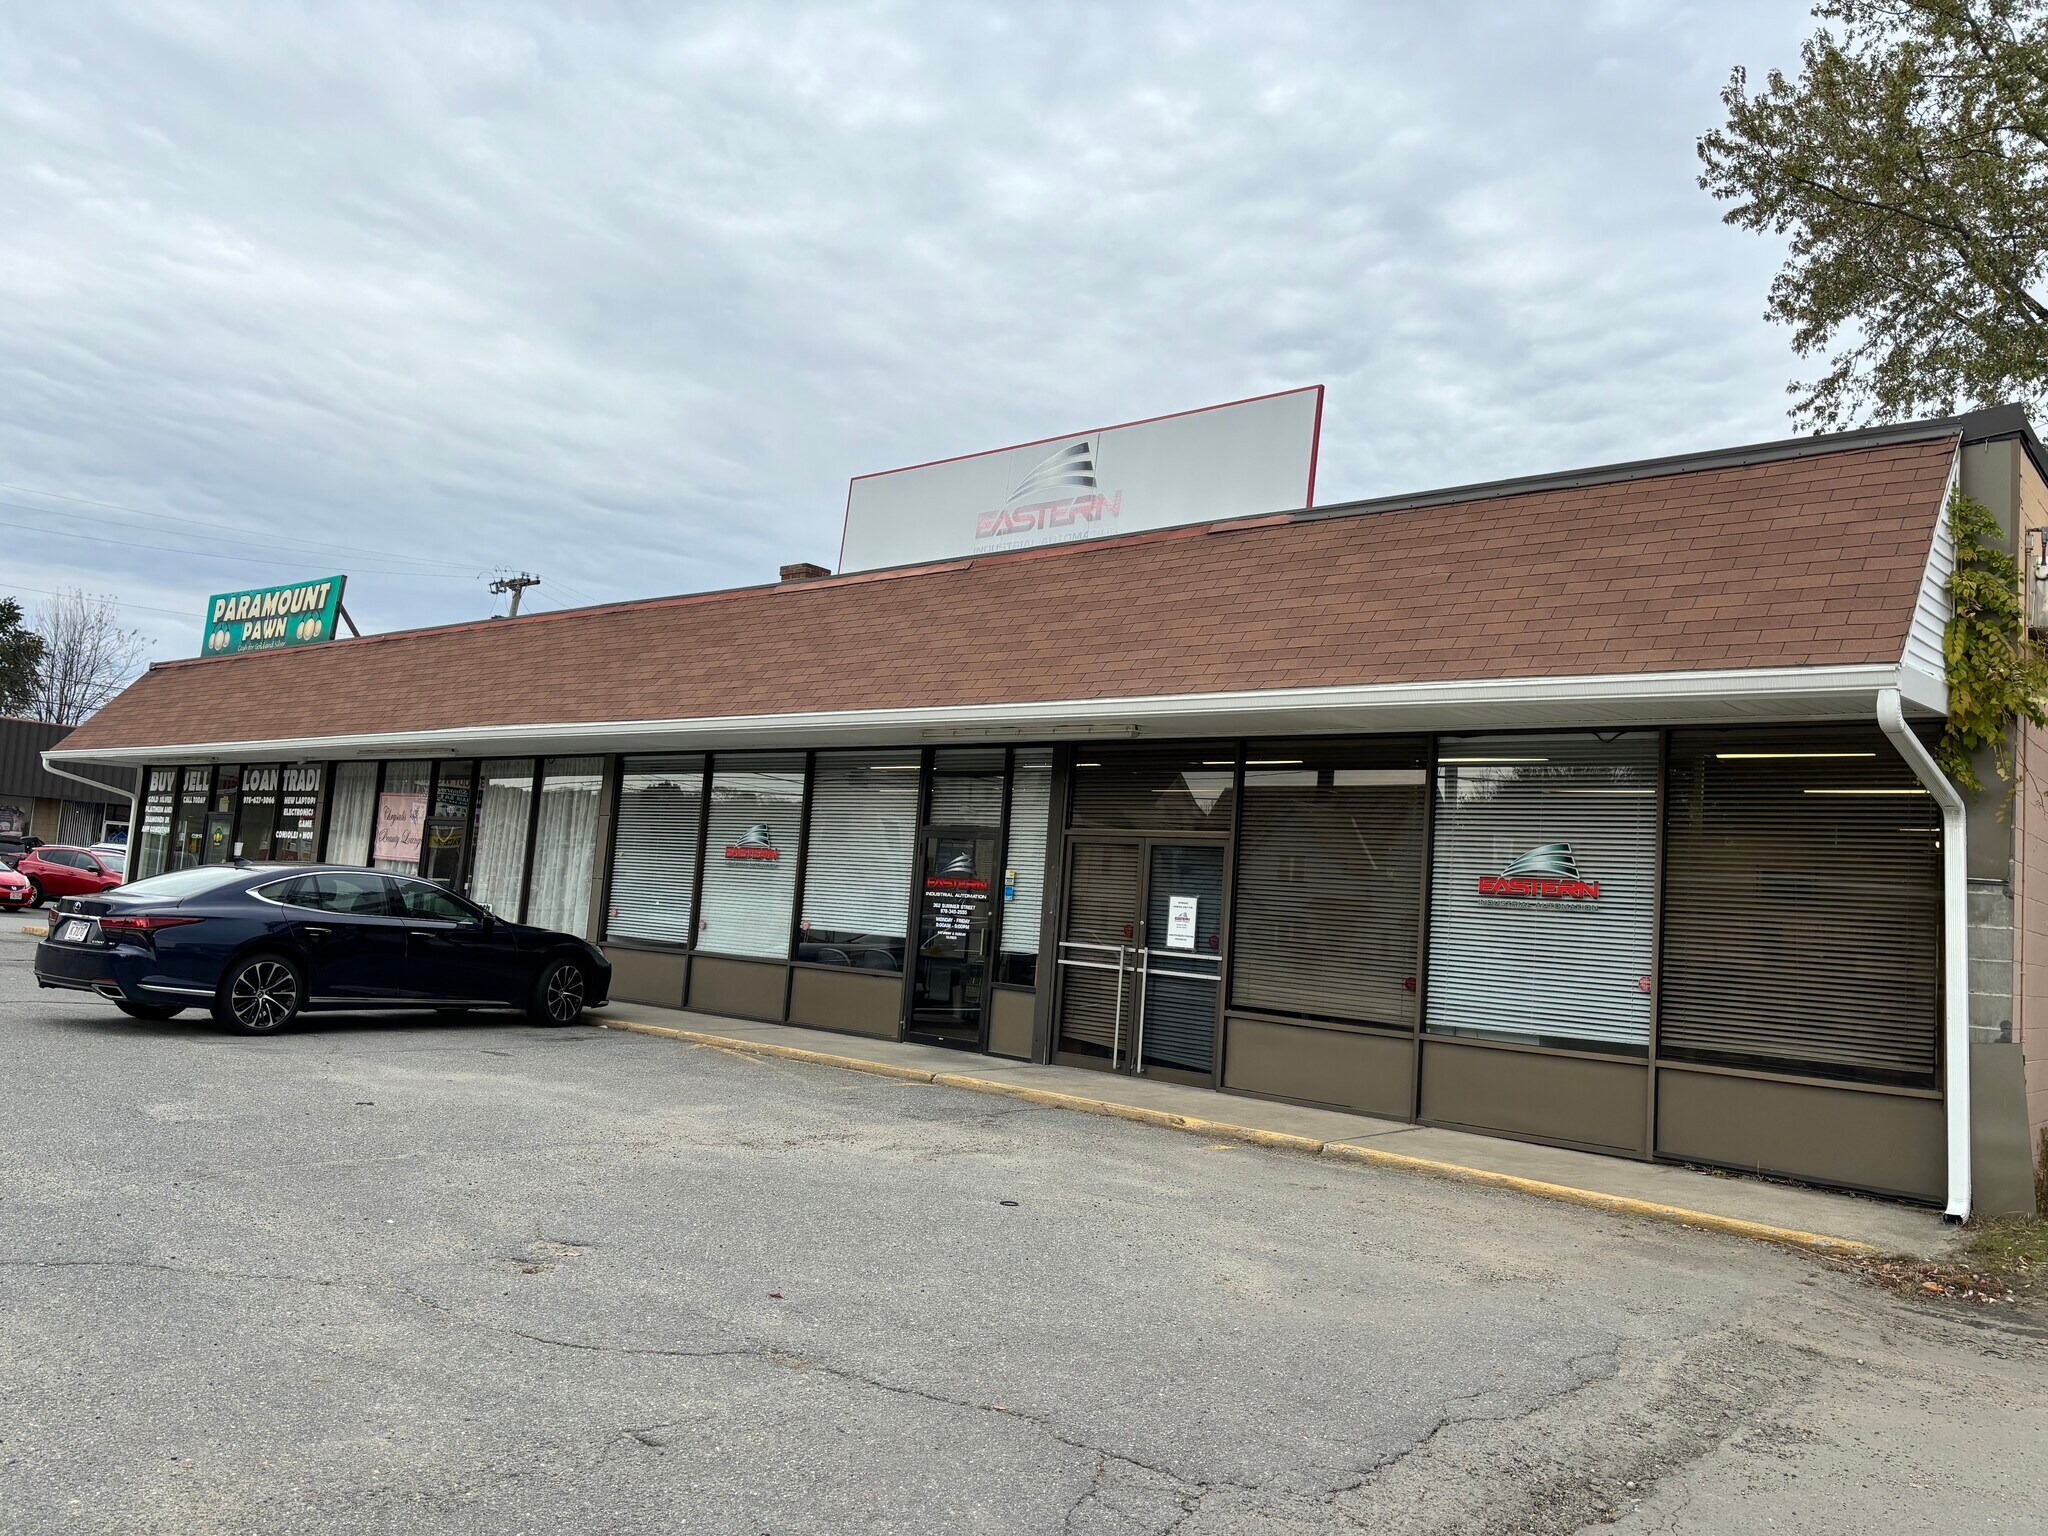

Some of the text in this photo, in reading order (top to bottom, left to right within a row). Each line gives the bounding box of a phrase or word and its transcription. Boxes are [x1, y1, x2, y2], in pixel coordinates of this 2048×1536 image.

[975, 489, 1122, 539] EASTERN
[213, 582, 331, 623] PARAMOUNT
[242, 617, 287, 641] PAWN
[150, 771, 209, 791] BUY SELL
[242, 769, 279, 791] LOAN
[148, 795, 159, 803] GOLD
[183, 796, 206, 804] CALL TODAY
[284, 796, 295, 804] NEW
[283, 808, 314, 816] ELECTRONICS
[298, 819, 313, 828] GAME
[275, 830, 299, 839] CONSOLES
[927, 878, 988, 890] EASTERN
[1478, 876, 1599, 900] EASTERN
